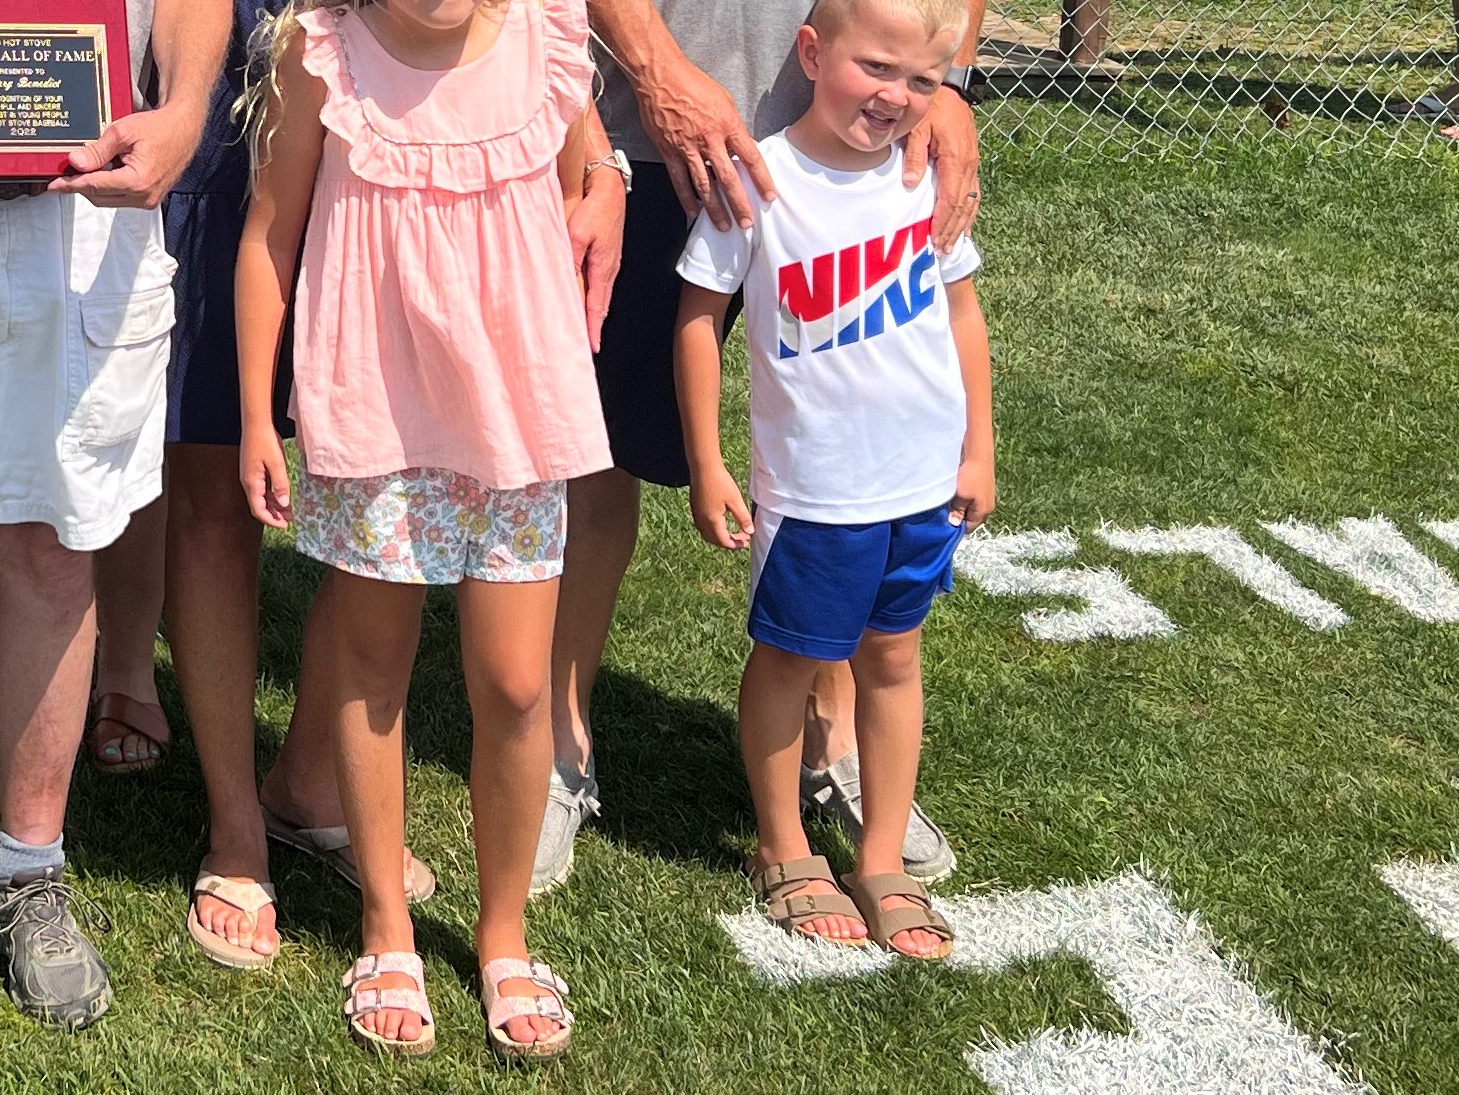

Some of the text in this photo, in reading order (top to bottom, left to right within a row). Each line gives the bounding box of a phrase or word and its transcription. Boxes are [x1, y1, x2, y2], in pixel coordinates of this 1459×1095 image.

[3, 38, 21, 47] HOT
[23, 38, 52, 47] STOVE
[33, 49, 52, 62] OF
[55, 49, 95, 62] FAME
[35, 68, 46, 76] TO
[33, 95, 43, 103] OF
[44, 95, 64, 103] YOUR
[17, 111, 41, 119] YOUNG
[41, 111, 70, 119] PEOPLE
[8, 119, 32, 127] STOVE
[32, 119, 71, 128] BASEBALL
[10, 127, 38, 136] 2022
